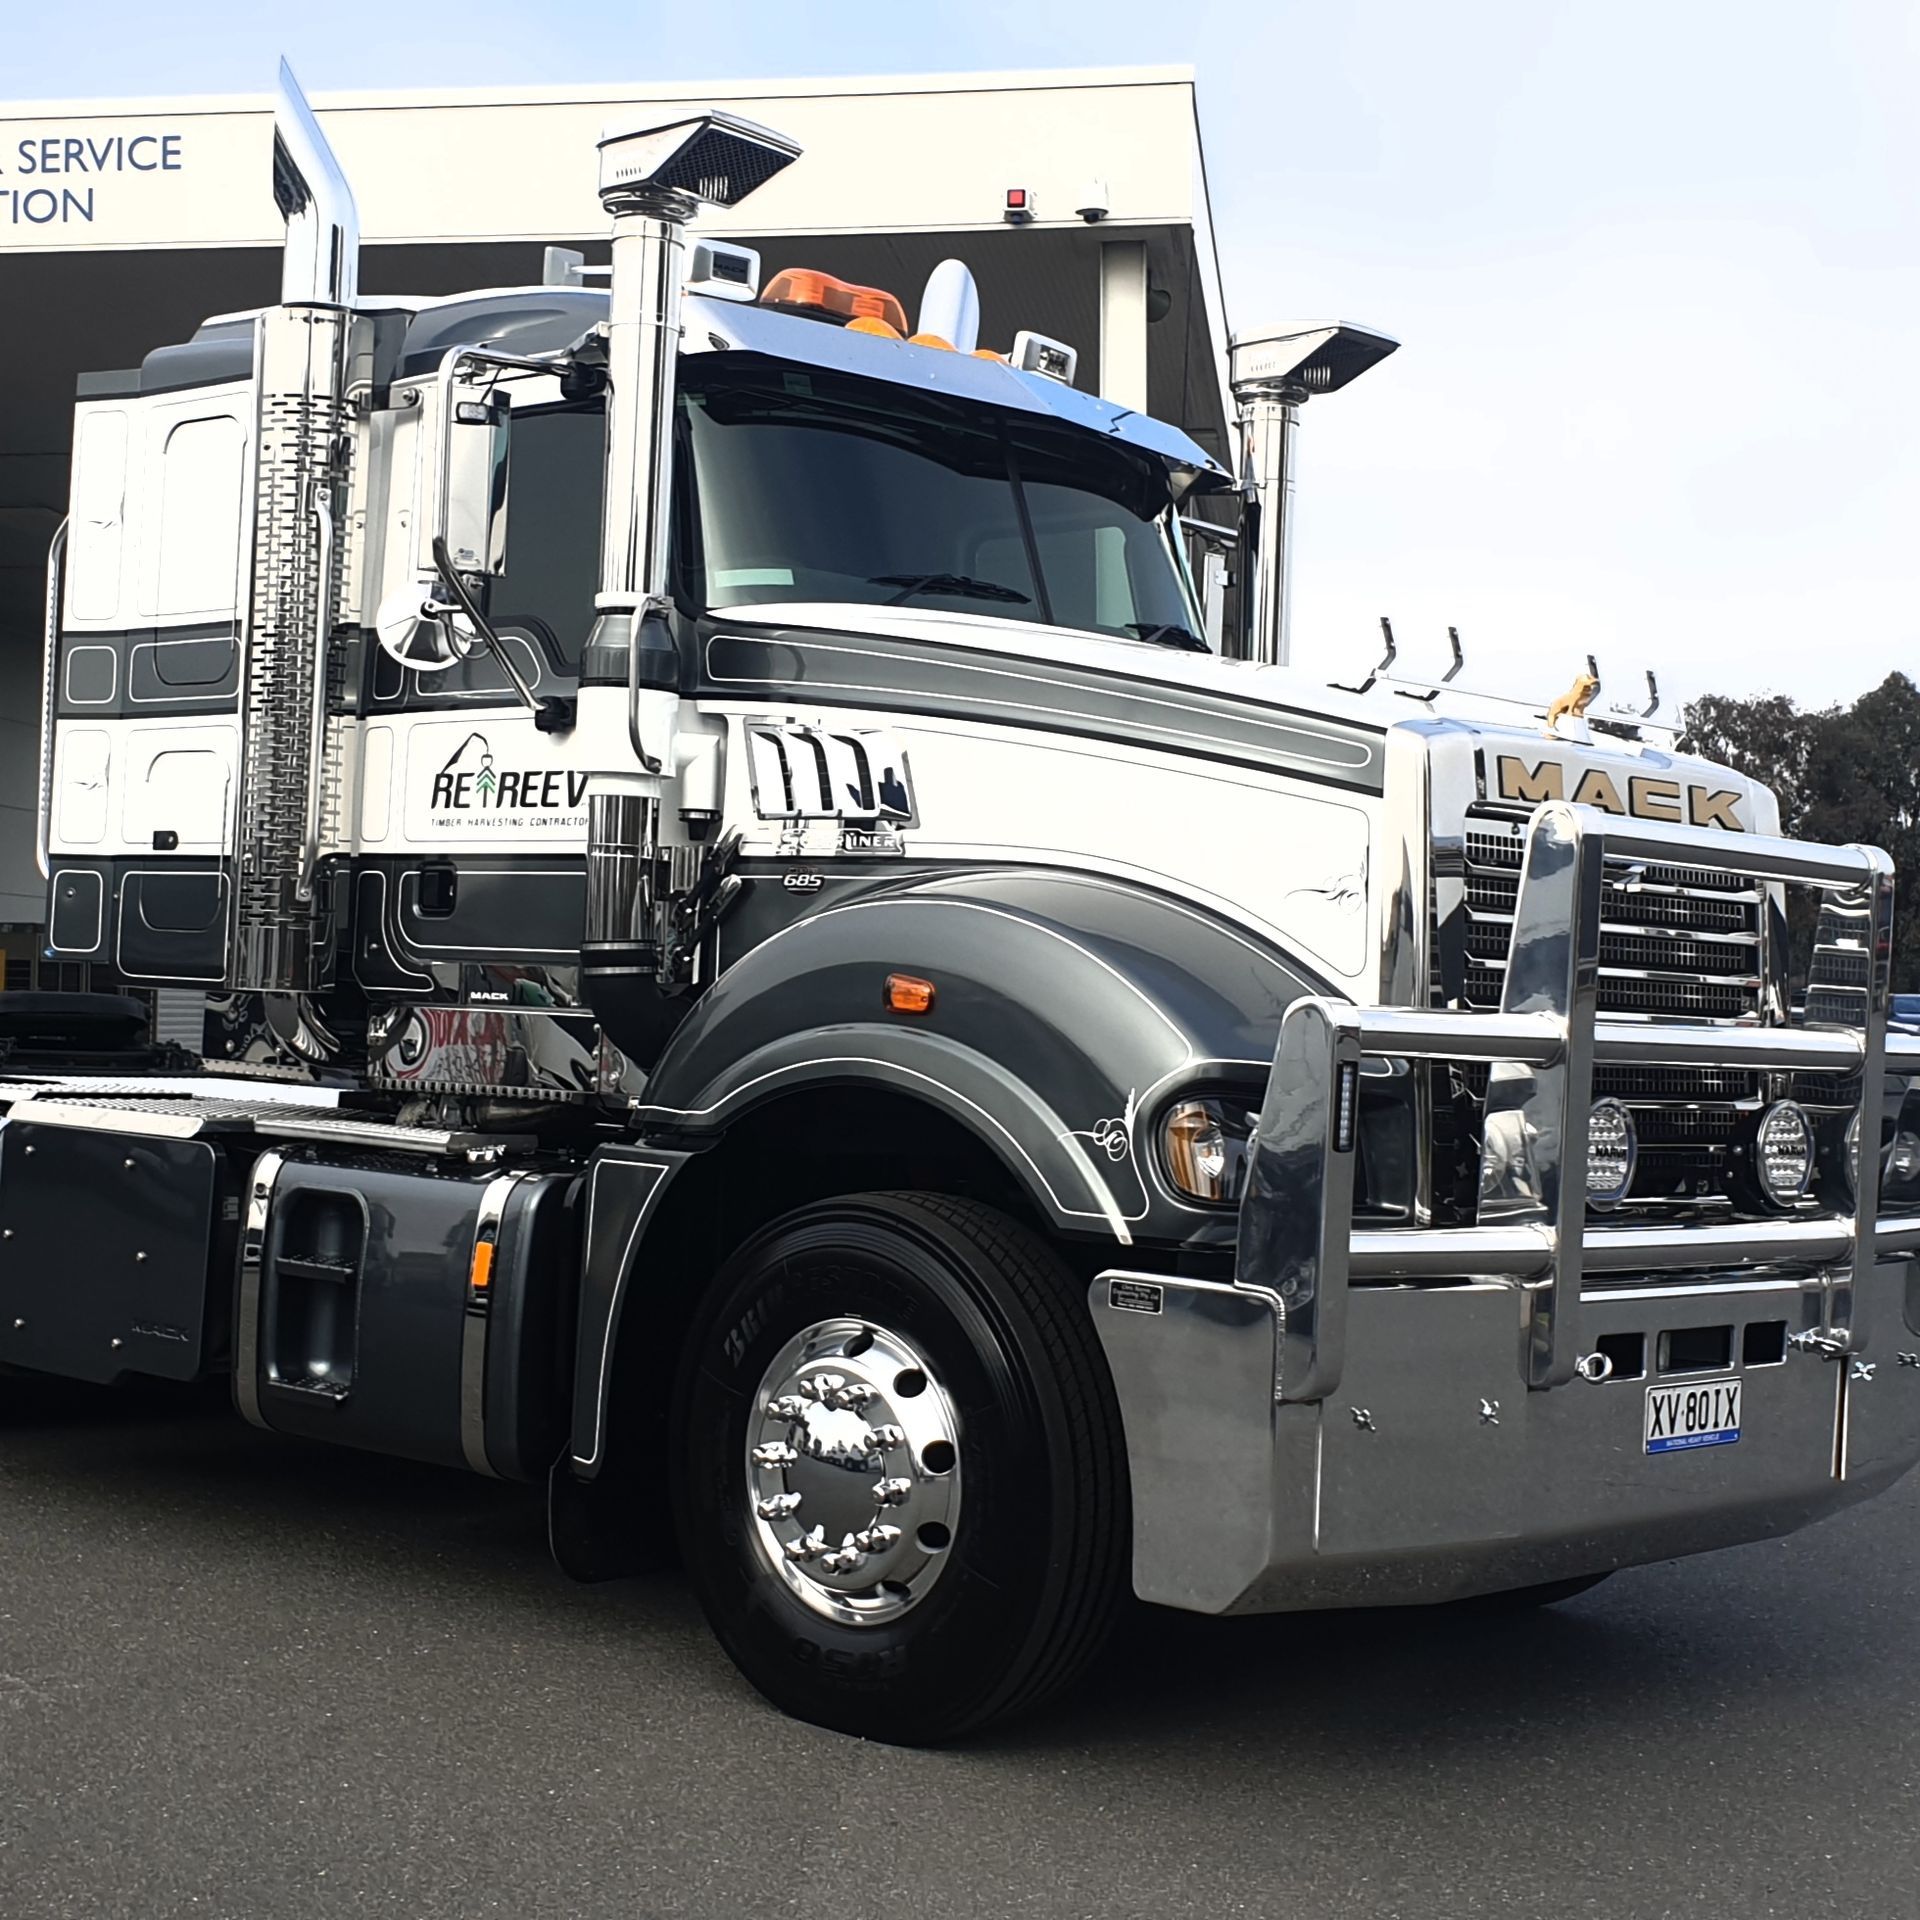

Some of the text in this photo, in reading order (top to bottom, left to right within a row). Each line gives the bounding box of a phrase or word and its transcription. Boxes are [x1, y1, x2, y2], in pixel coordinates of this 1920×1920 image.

[18, 135, 182, 174] SERVICE
[1496, 754, 1745, 832] MACK
[431, 818, 462, 827] TIMBER
[468, 817, 524, 827] HARVESTING
[783, 874, 822, 887] 685
[470, 991, 509, 1001] MACK
